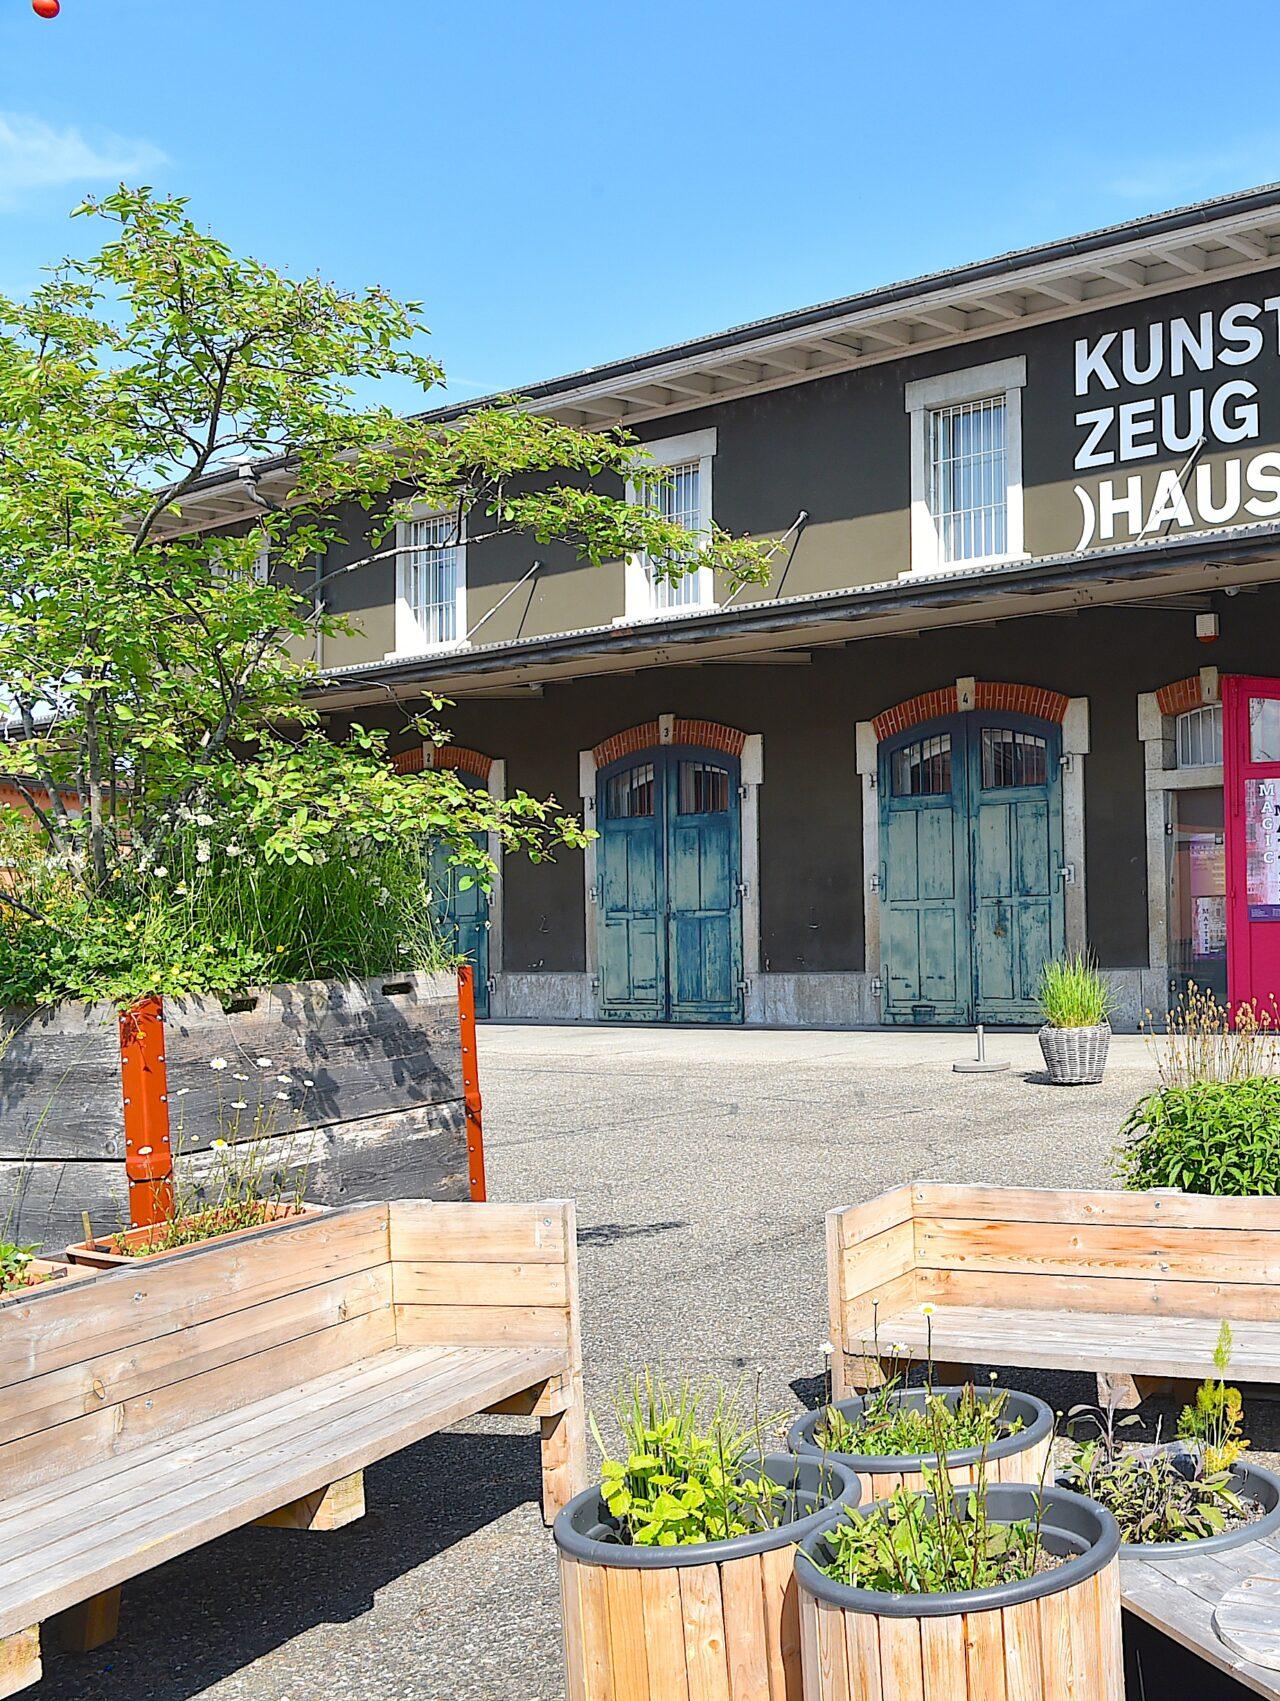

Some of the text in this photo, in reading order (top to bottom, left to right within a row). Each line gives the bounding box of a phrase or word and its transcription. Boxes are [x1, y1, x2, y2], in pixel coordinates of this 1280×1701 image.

[1074, 380, 1260, 471] ZEUG
[962, 692, 969, 704] 4
[664, 728, 669, 737] 3
[426, 753, 432, 762] 2
[1258, 784, 1276, 865] MAGIC
